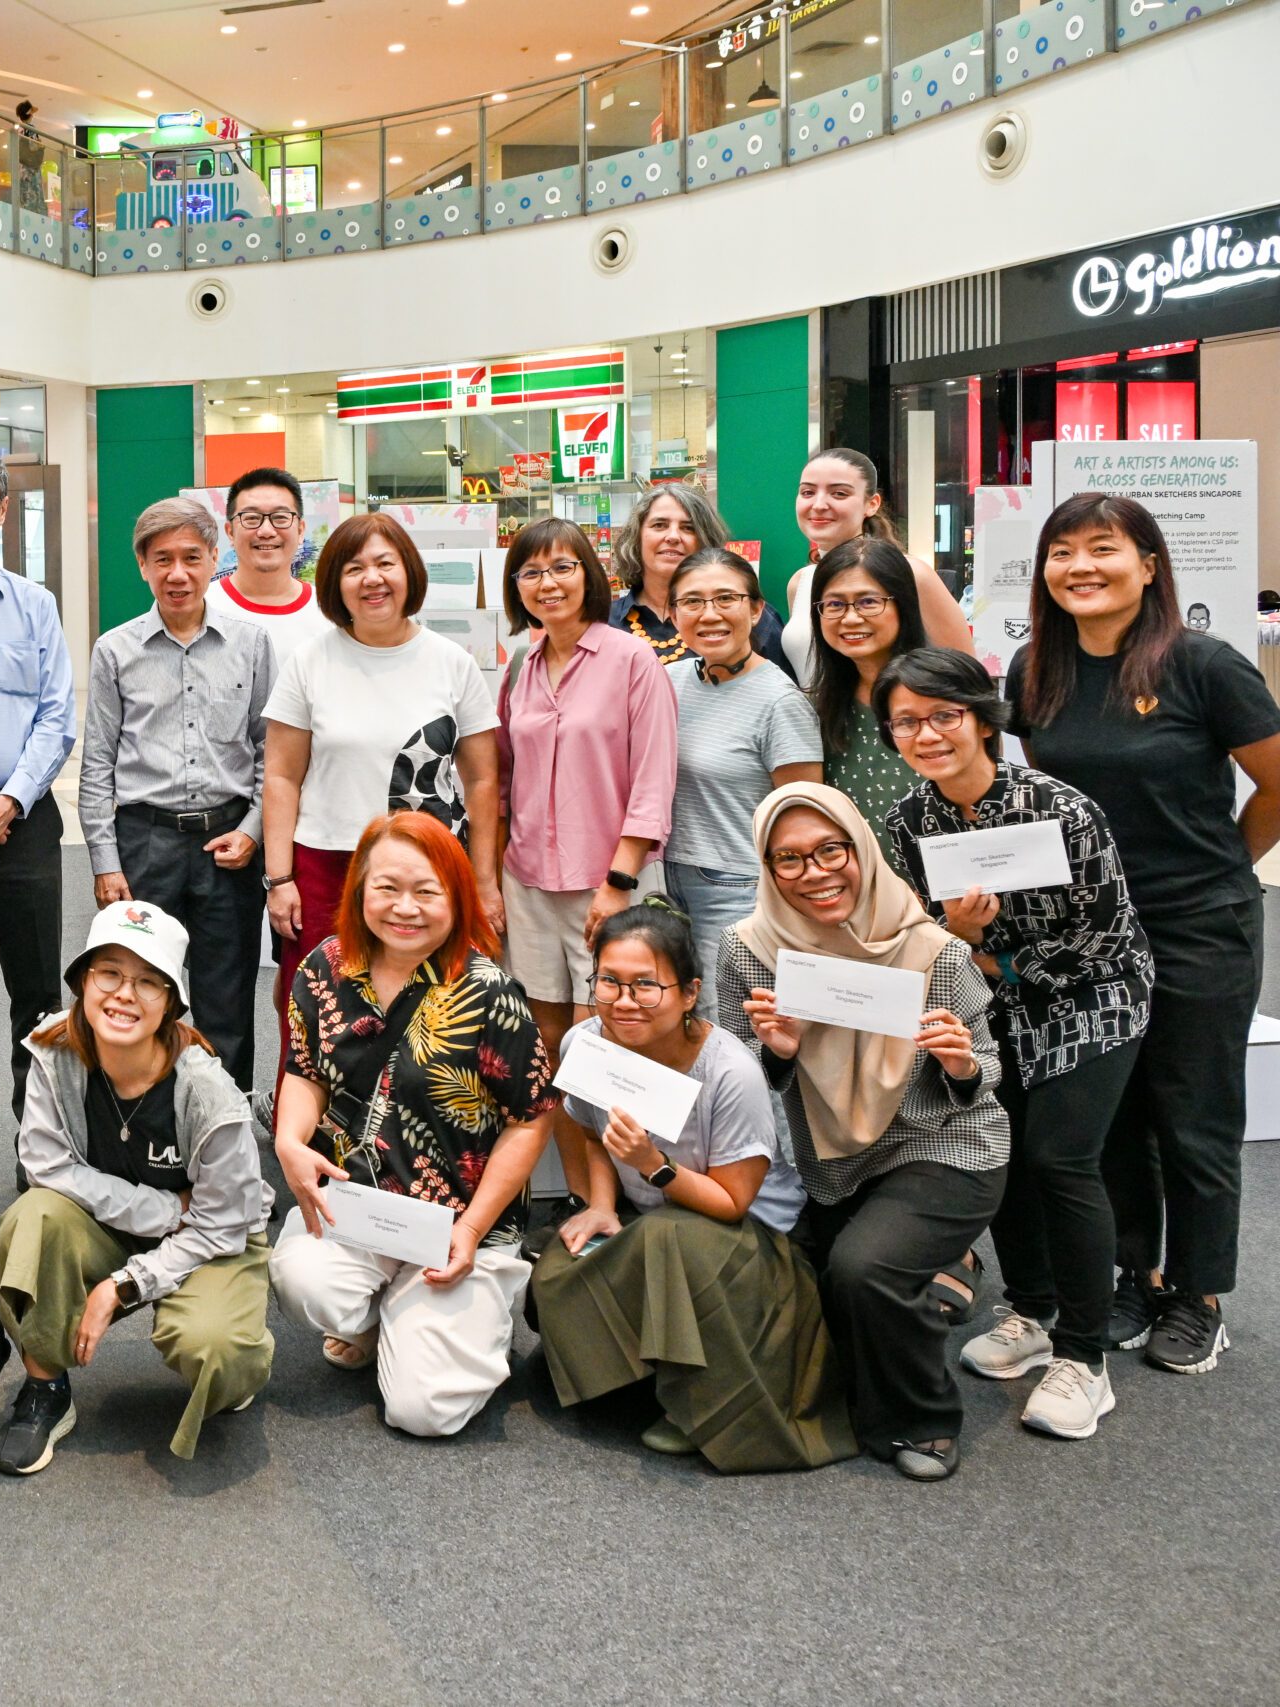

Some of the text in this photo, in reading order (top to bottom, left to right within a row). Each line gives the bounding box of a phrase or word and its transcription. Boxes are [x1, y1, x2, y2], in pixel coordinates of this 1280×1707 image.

[1125, 225, 1280, 315] Goldlion
[1061, 424, 1103, 441] SALE
[1139, 424, 1182, 441] SALE
[564, 441, 608, 457] ELEVEn
[1074, 456, 1239, 470] ART & ARTISTS AMONG US:
[1087, 473, 1227, 488] ACROSS GENERATIONS
